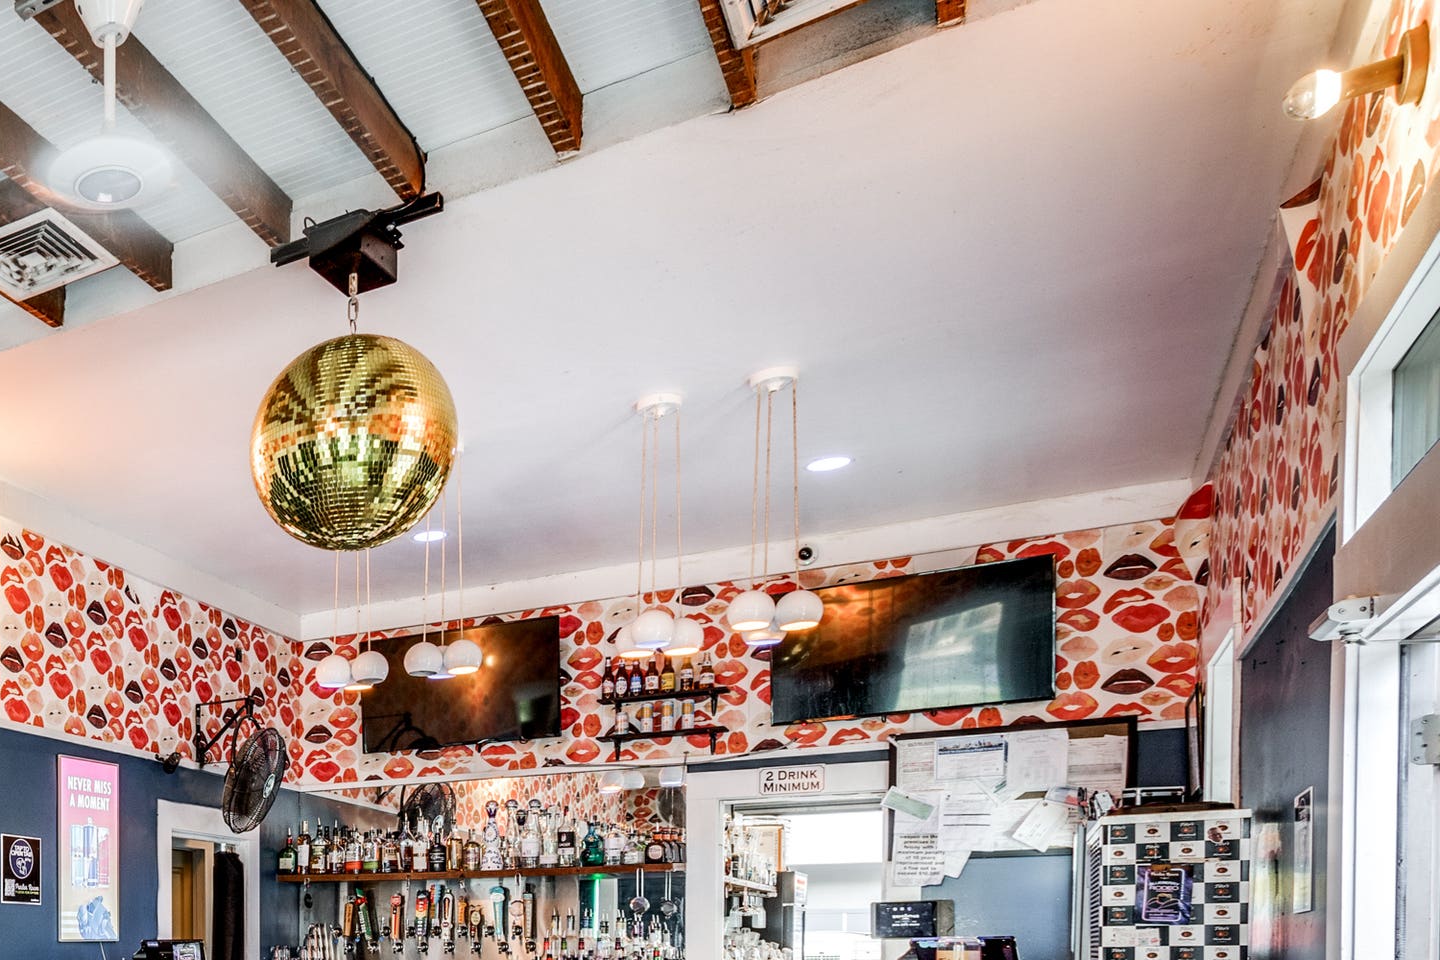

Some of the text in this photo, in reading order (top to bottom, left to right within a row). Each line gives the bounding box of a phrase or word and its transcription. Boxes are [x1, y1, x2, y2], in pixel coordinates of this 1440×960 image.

[766, 770, 817, 781] 2 DRINK
[67, 775, 112, 795] NEVER MISS
[764, 781, 820, 793] MINIMUM
[70, 794, 110, 812] A MOMENT
